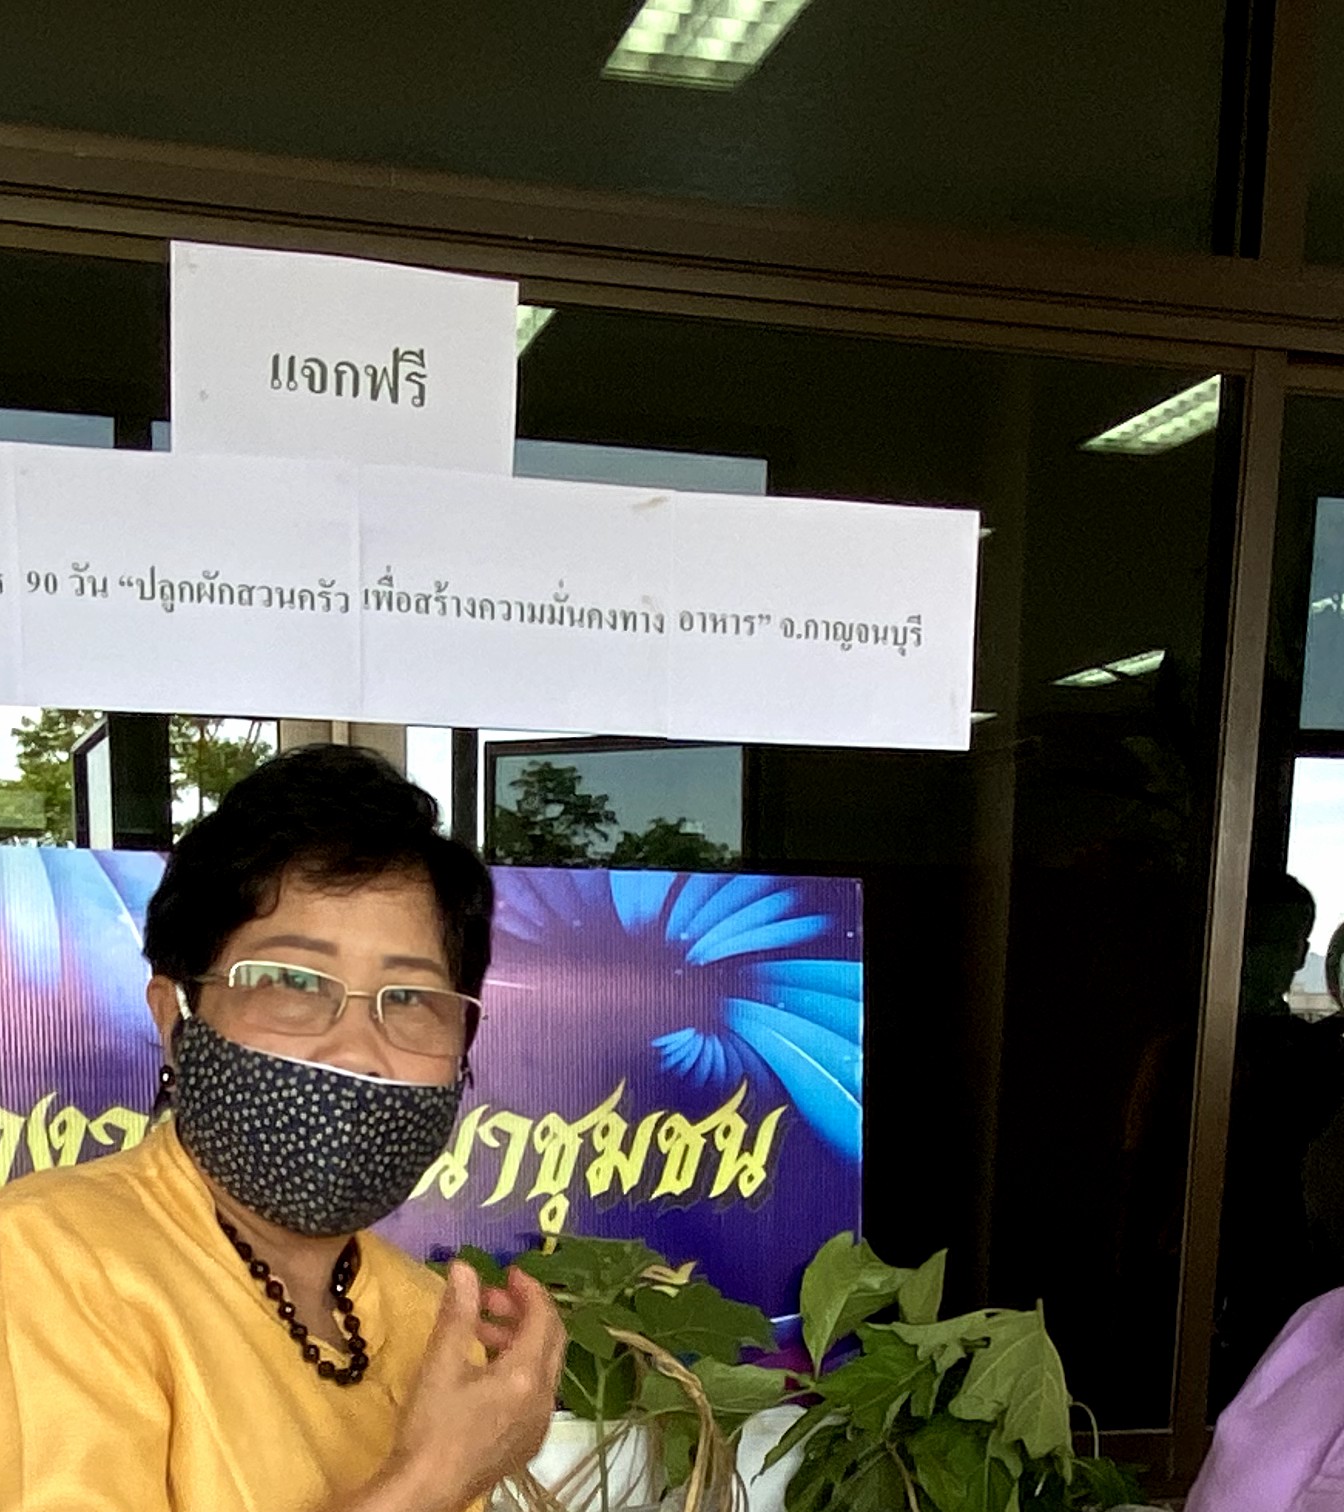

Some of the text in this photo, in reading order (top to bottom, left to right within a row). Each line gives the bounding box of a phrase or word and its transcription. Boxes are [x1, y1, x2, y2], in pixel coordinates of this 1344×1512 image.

[268, 346, 429, 409] แจกฟรี
[25, 569, 59, 598] 90
[67, 562, 109, 599] วัน
